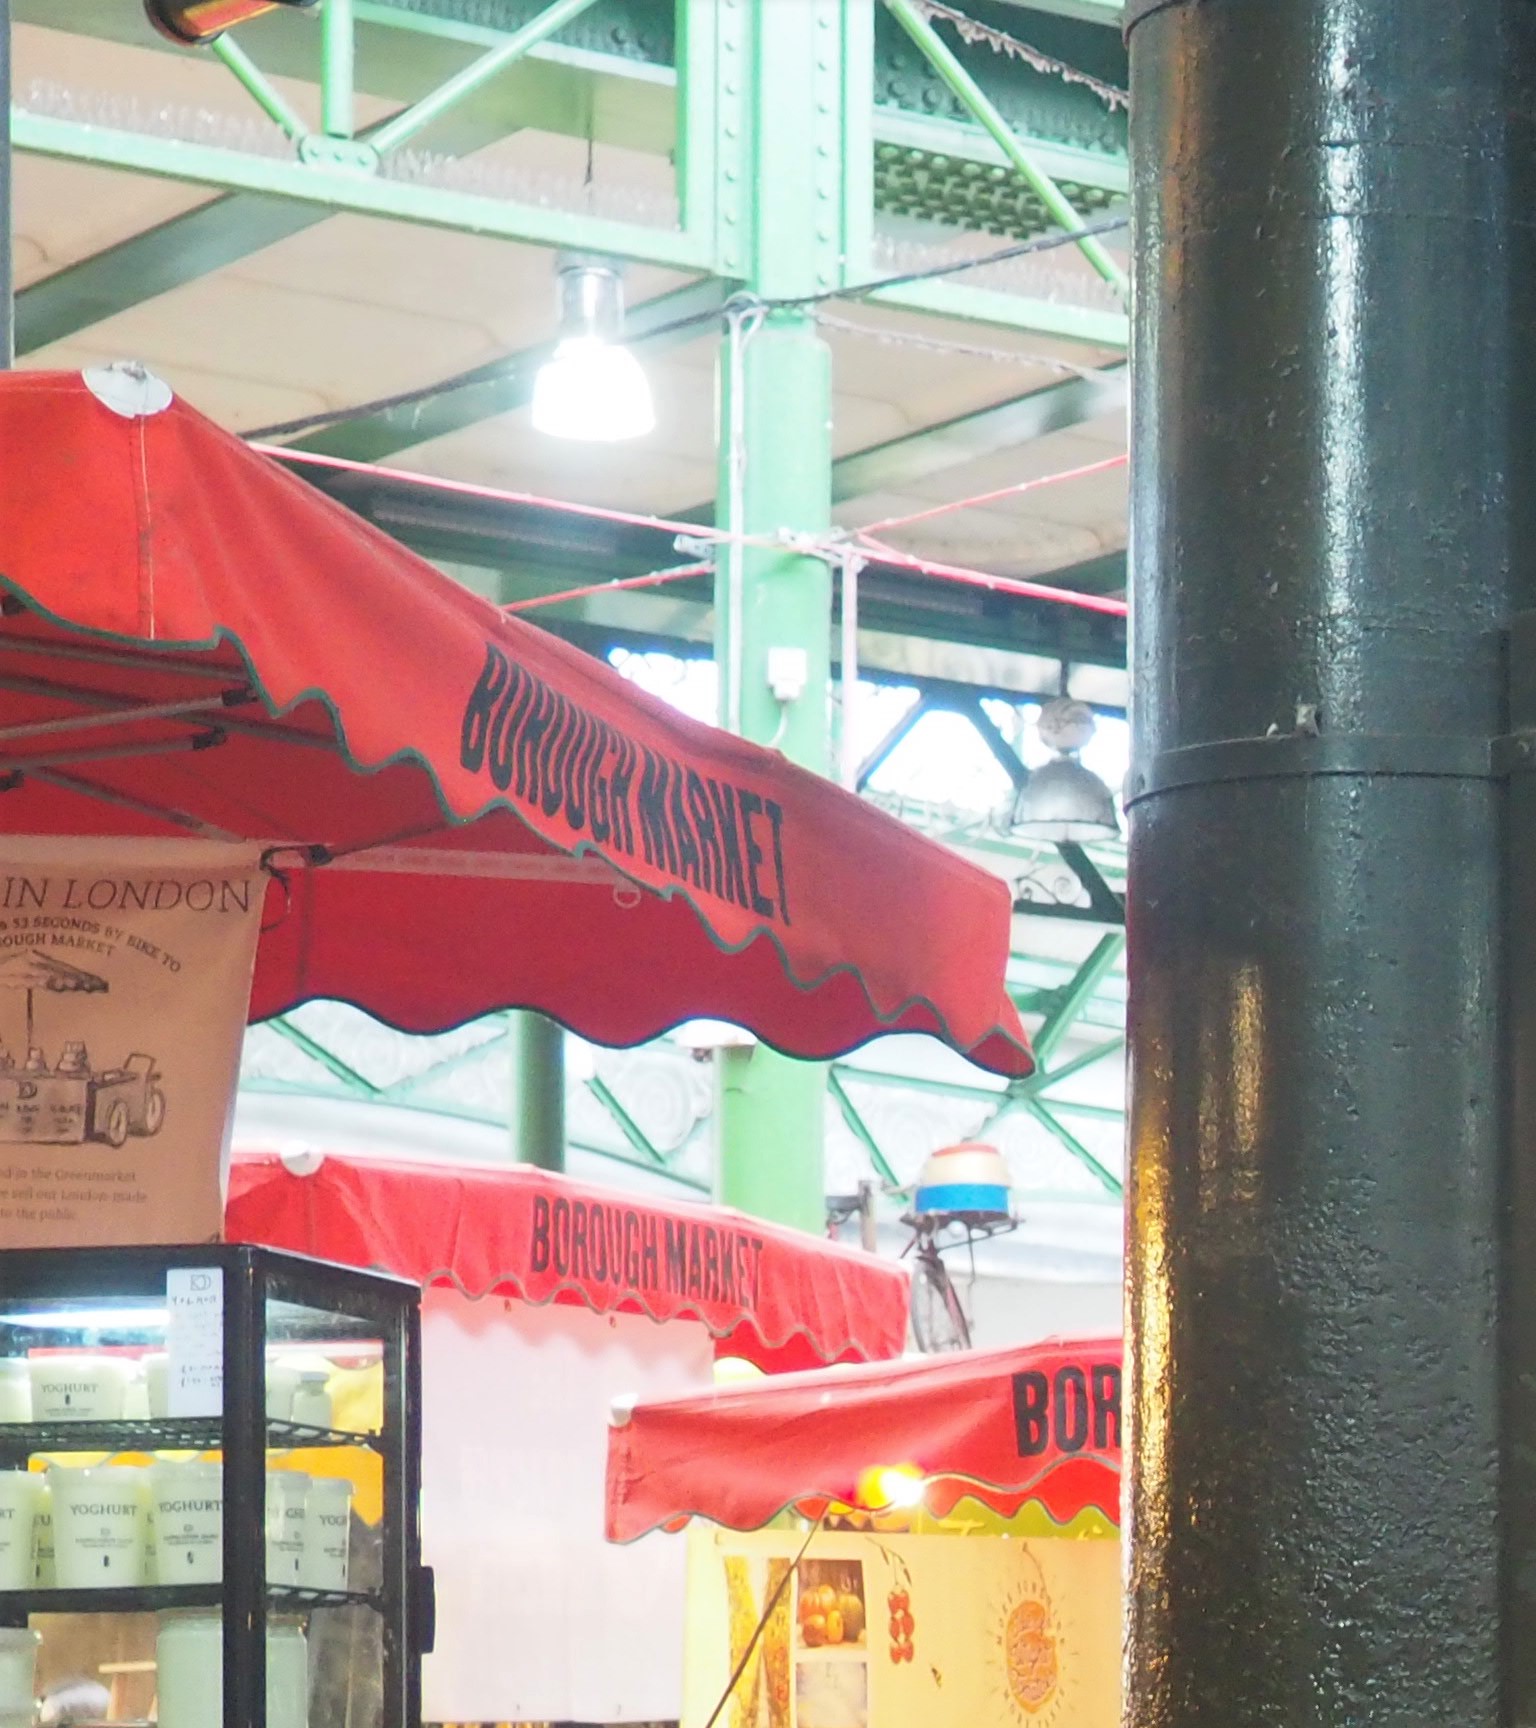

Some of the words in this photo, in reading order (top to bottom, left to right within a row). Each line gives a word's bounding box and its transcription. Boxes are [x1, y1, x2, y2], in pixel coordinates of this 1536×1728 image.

[460, 641, 637, 857] BOROUGH
[638, 742, 792, 927] MARKET
[63, 879, 250, 913] LONDON
[0, 933, 46, 948] OUGH
[51, 933, 117, 957] MARKET
[33, 916, 101, 934] SECONDS
[162, 952, 182, 974] TO
[531, 1195, 659, 1290] BOROUGH
[662, 1217, 763, 1312] MARKET
[41, 1382, 99, 1395] YOGHURT
[70, 1503, 138, 1517] YOGHURT
[158, 1500, 223, 1514] YOGHURT
